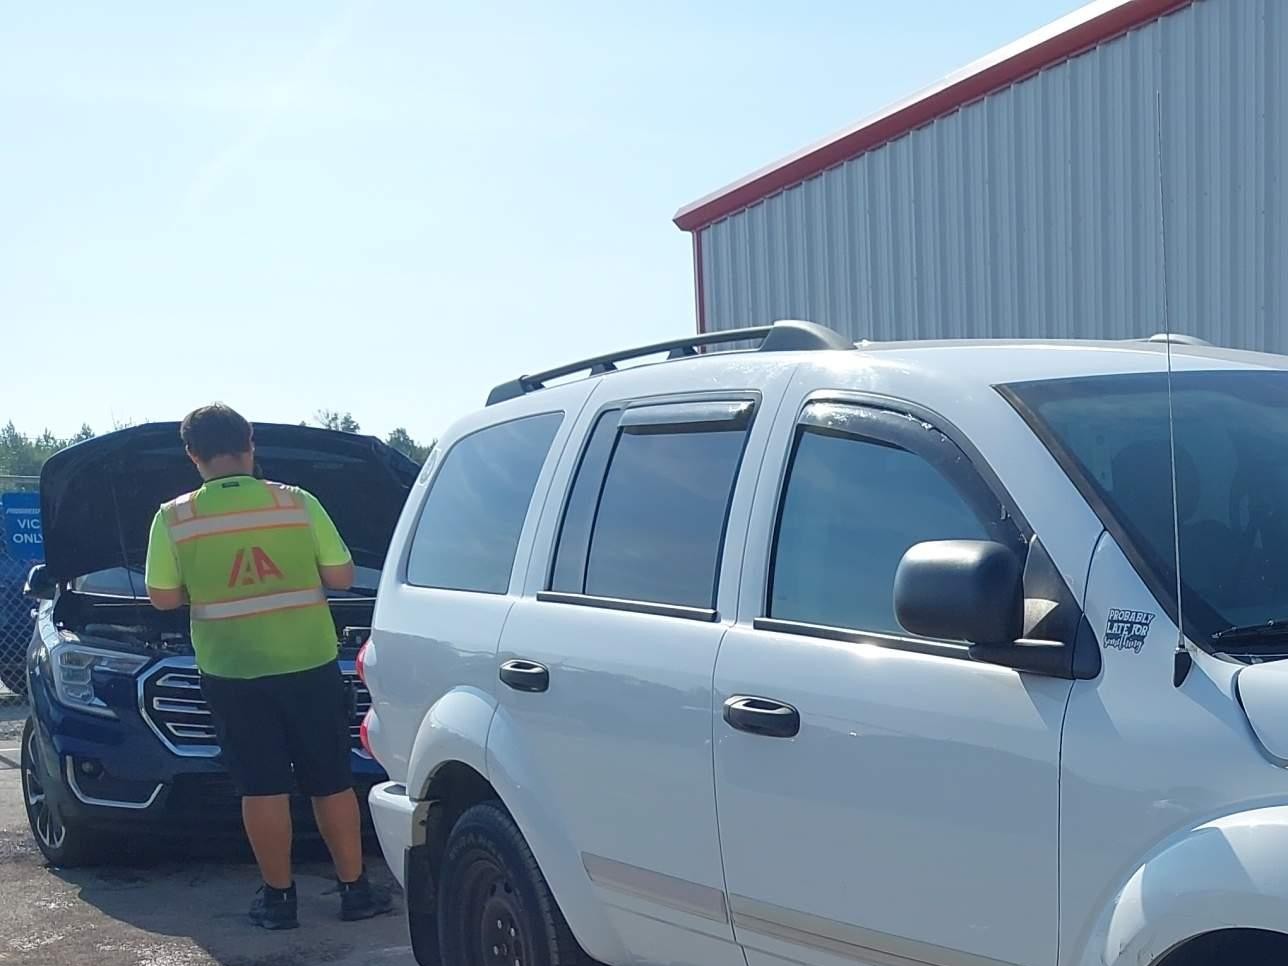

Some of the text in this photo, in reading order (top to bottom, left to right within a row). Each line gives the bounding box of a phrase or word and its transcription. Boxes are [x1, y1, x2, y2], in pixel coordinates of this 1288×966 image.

[1109, 609, 1154, 624] PROBABLY
[1106, 621, 1149, 636] LATE FOR
